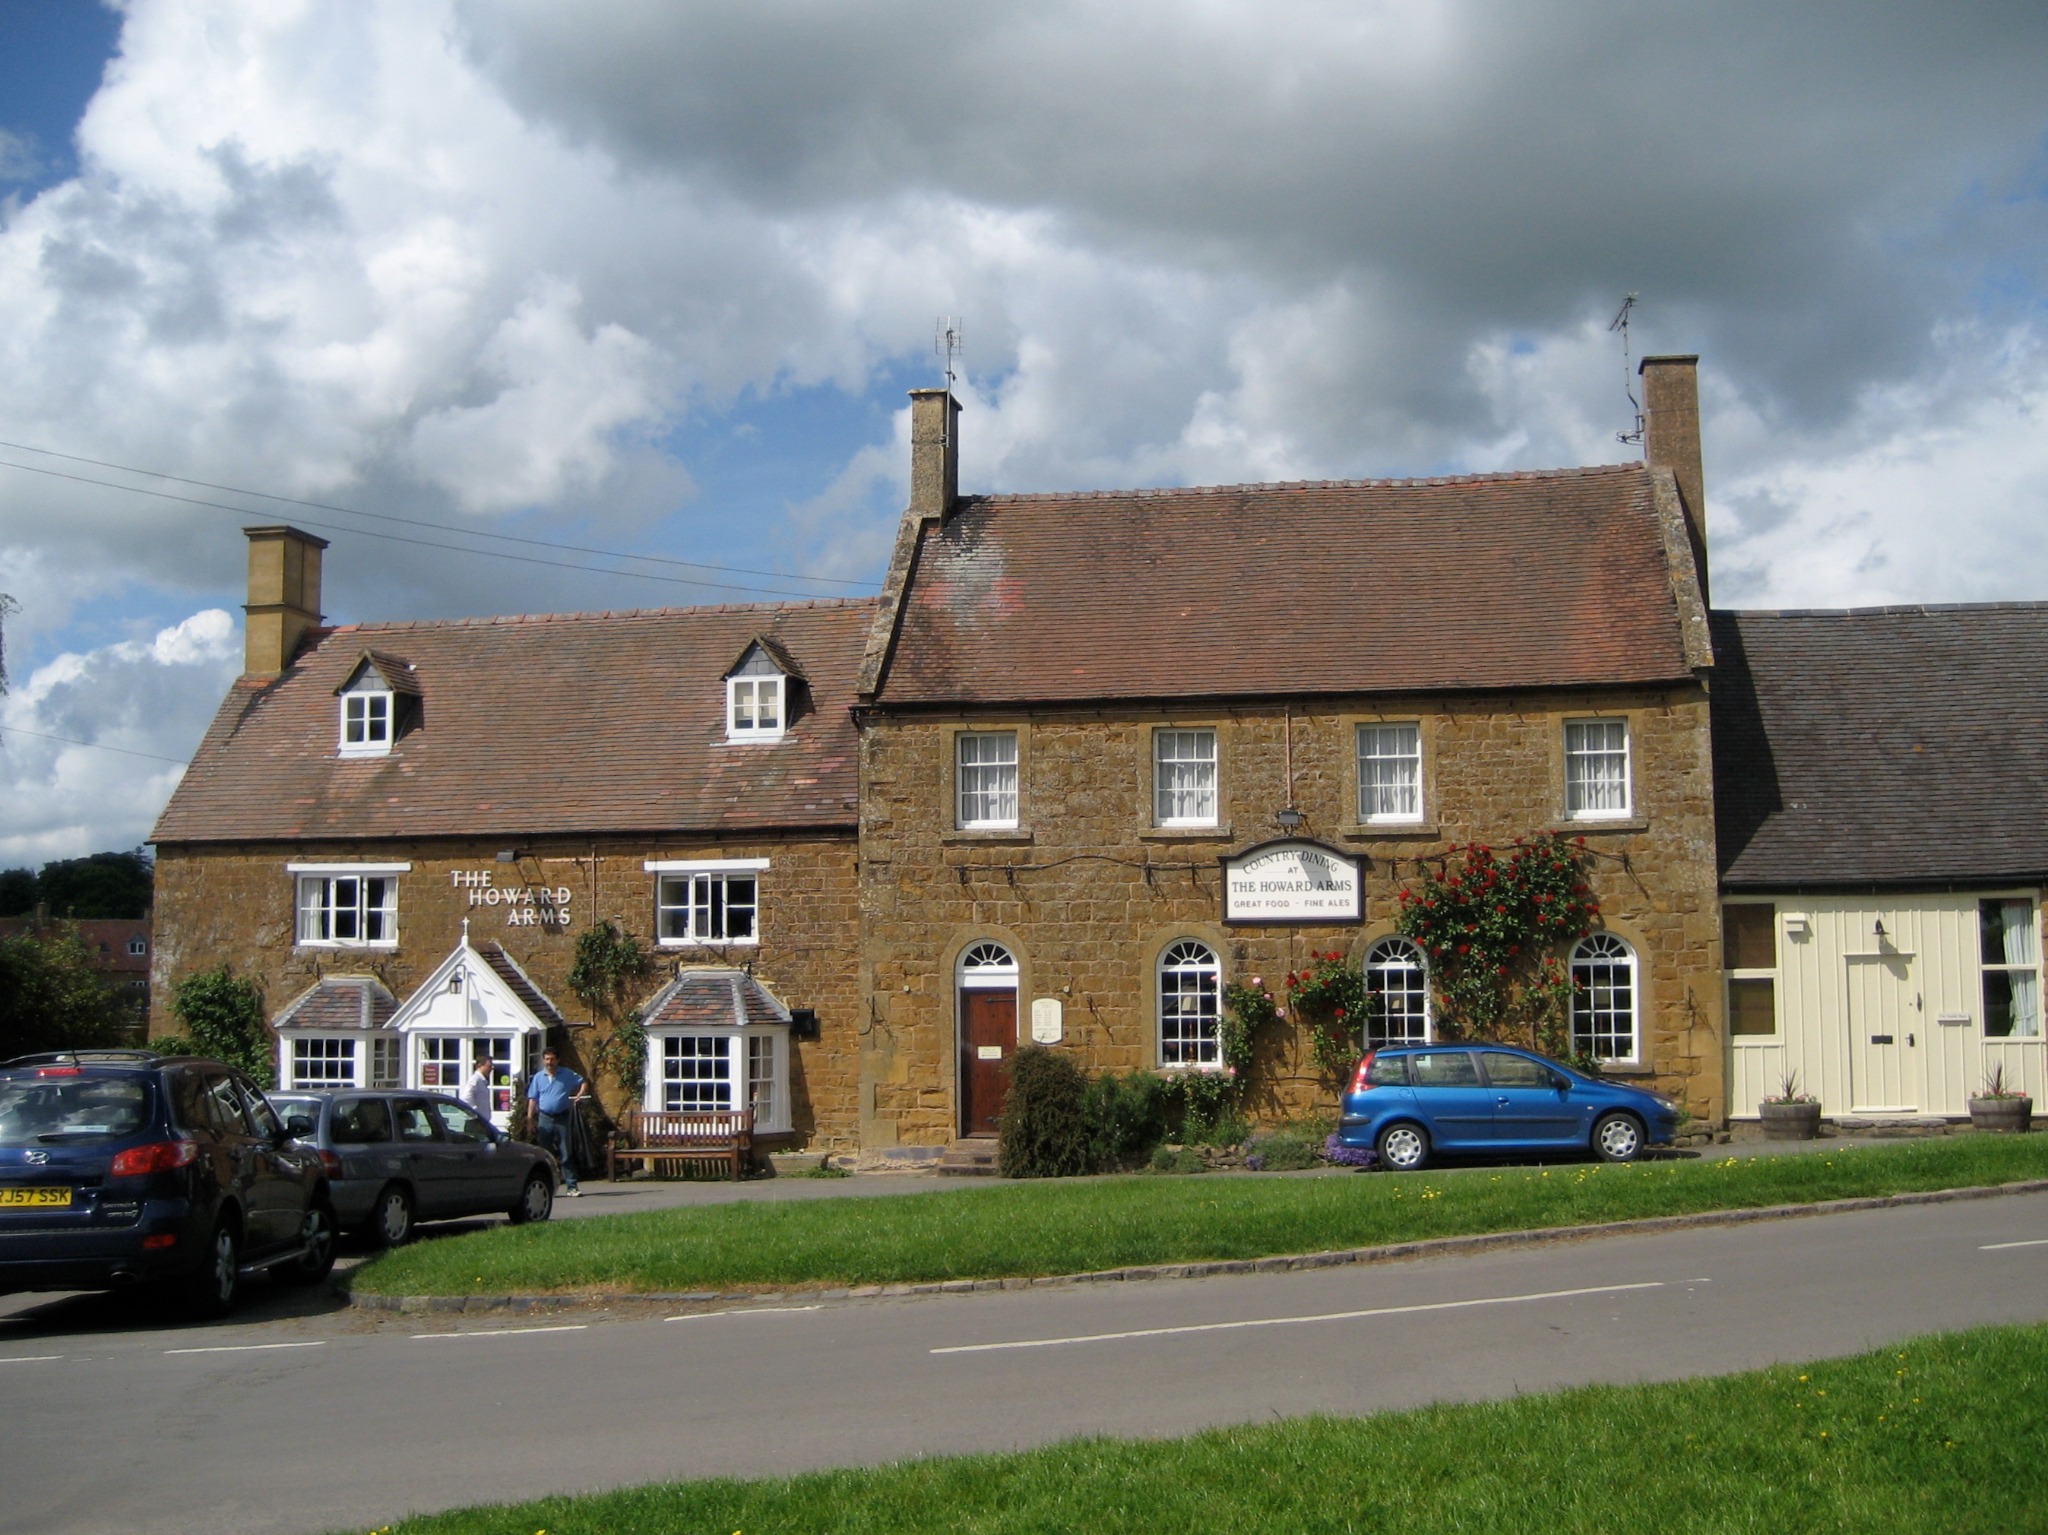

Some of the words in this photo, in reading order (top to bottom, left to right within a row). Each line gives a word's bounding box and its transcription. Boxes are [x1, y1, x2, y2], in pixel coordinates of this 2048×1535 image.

[1242, 849, 1298, 875] COUNTRY
[1301, 850, 1340, 873] DINING
[1287, 866, 1299, 874] AT
[450, 870, 492, 888] THE
[1231, 881, 1256, 893] THE
[1260, 880, 1313, 893] HOWARD
[1316, 879, 1353, 892] ARMS
[469, 887, 571, 906] HOWARD
[1233, 900, 1262, 908] GREAT
[1265, 900, 1290, 908] FOOD
[1304, 899, 1325, 907] FINE
[1327, 898, 1351, 907] ALES
[507, 907, 571, 926] ARMS
[38, 1188, 70, 1203] SSK
